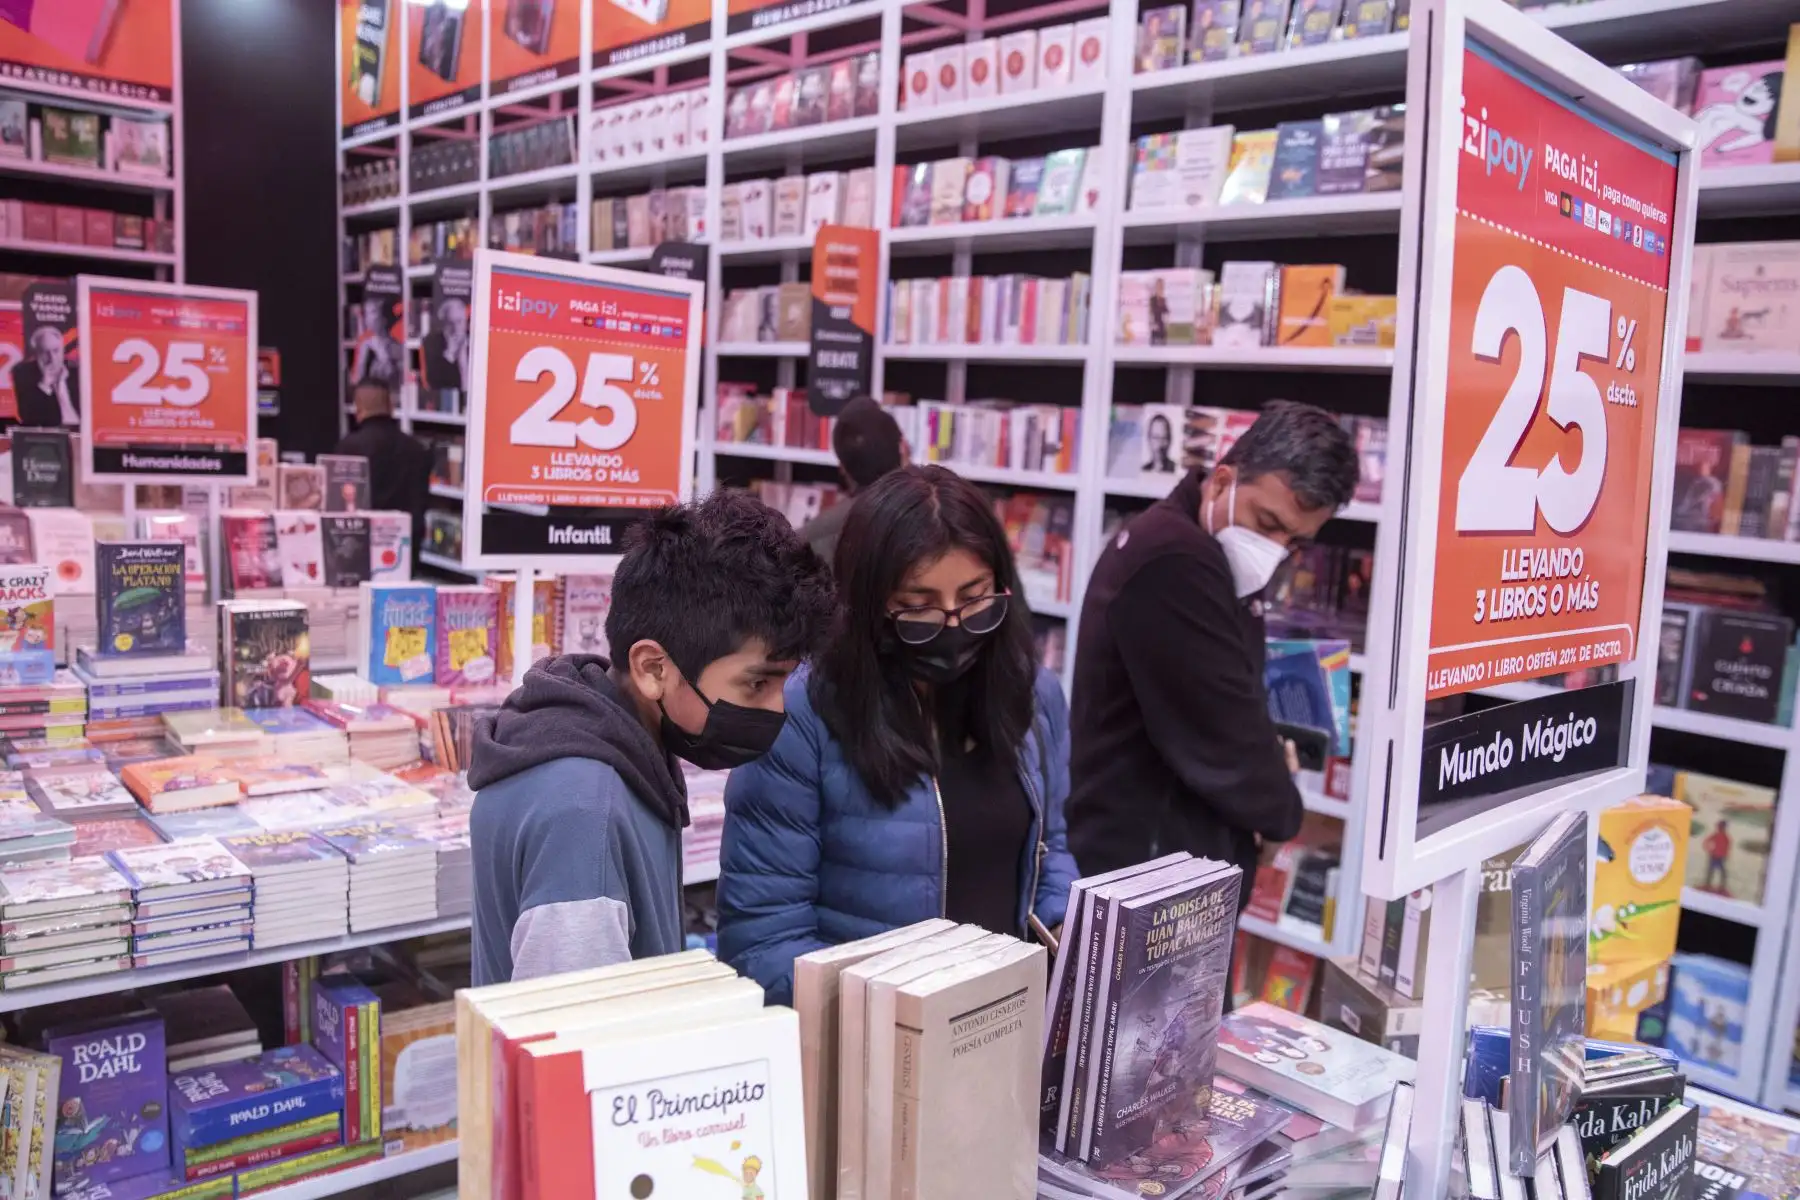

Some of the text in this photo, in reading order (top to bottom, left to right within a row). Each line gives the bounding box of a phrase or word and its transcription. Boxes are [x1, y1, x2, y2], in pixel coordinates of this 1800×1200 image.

[0, 63, 82, 88] ERATURA
[1544, 189, 1558, 207] VISA
[1545, 144, 1578, 184] PAGA
[1603, 183, 1621, 206] paga
[1622, 193, 1641, 212] como
[1641, 201, 1668, 224] quieras
[498, 289, 558, 319] izipay
[570, 300, 599, 313] PAGA
[111, 338, 211, 407] 25
[511, 346, 660, 450] 25 %
[1455, 265, 1637, 537] 25 %
[1607, 380, 1638, 407] dscto.
[122, 453, 222, 471] Humanidades
[531, 466, 640, 483] 3 LIBROS O MÁS
[551, 452, 622, 468] LLEVANDO
[549, 526, 611, 545] Infantil
[9, 576, 46, 587] CRAZY
[1501, 547, 1583, 582] LLEVANDO
[1474, 574, 1600, 623] 3 LIBROS O MÁS
[1428, 640, 1622, 690] LLEVANDO 1 LIBRO OBTÉN 20% DE DSCTO.
[1438, 712, 1597, 791] Mundo Mágico
[1153, 888, 1224, 926] LA ODISEA DE
[1520, 888, 1532, 953] Virginia Woolf
[1094, 931, 1100, 940] LA
[1145, 904, 1226, 945] JUAN BAUTISTA
[1146, 936, 1183, 961] TÚPAC
[1184, 922, 1222, 947] AMARU
[1091, 940, 1099, 965] ODISEA
[1116, 926, 1127, 981] CHARLES WALKER
[1087, 976, 1095, 990] JUAN
[951, 999, 1026, 1036] ANTONIO CISNEROS
[1110, 1001, 1119, 1025] AMARU
[1518, 961, 1532, 1073] FLUSH
[72, 1032, 146, 1066] ROALD
[952, 1017, 1024, 1058] POESÍA COMPLETA
[79, 1054, 142, 1084] DAHL
[1103, 1049, 1112, 1079] BAUTISTA
[611, 1080, 765, 1126] El Principito
[1101, 1079, 1109, 1095] JUAN
[1116, 1096, 1149, 1119] CHARLES
[1150, 1081, 1177, 1102] WALKER
[229, 1096, 306, 1126] ROALD DAHL
[1097, 1105, 1106, 1127] ODISEA
[1610, 1098, 1660, 1133] Kahl
[638, 1113, 748, 1148] Un libro carrusel
[1097, 1127, 1103, 1136] LA
[1625, 1162, 1658, 1200] Frida
[1660, 1134, 1693, 1181] Kahlo
